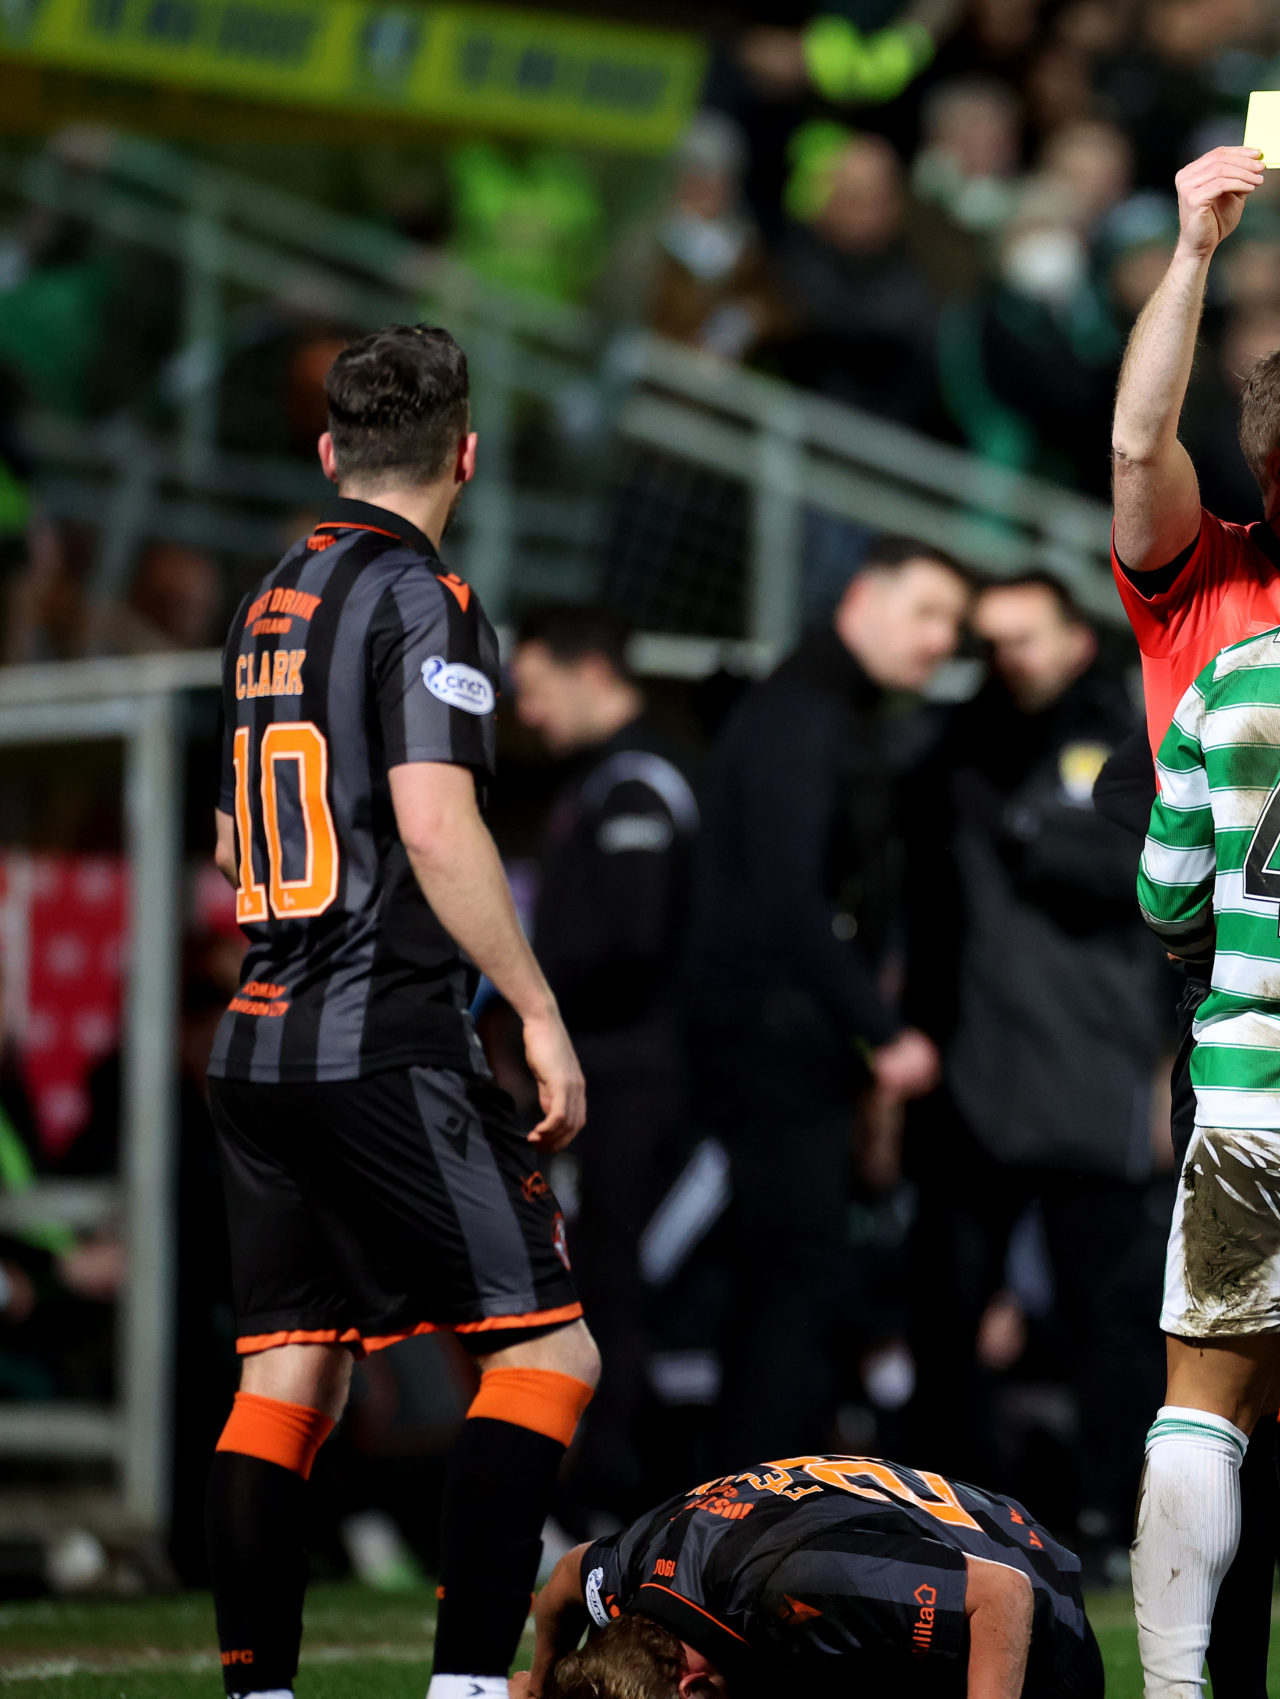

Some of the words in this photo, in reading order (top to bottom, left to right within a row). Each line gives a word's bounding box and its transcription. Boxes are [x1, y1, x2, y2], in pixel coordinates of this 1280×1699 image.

[235, 649, 307, 700] CLARK
[446, 671, 488, 699] cinch
[233, 721, 339, 924] 10
